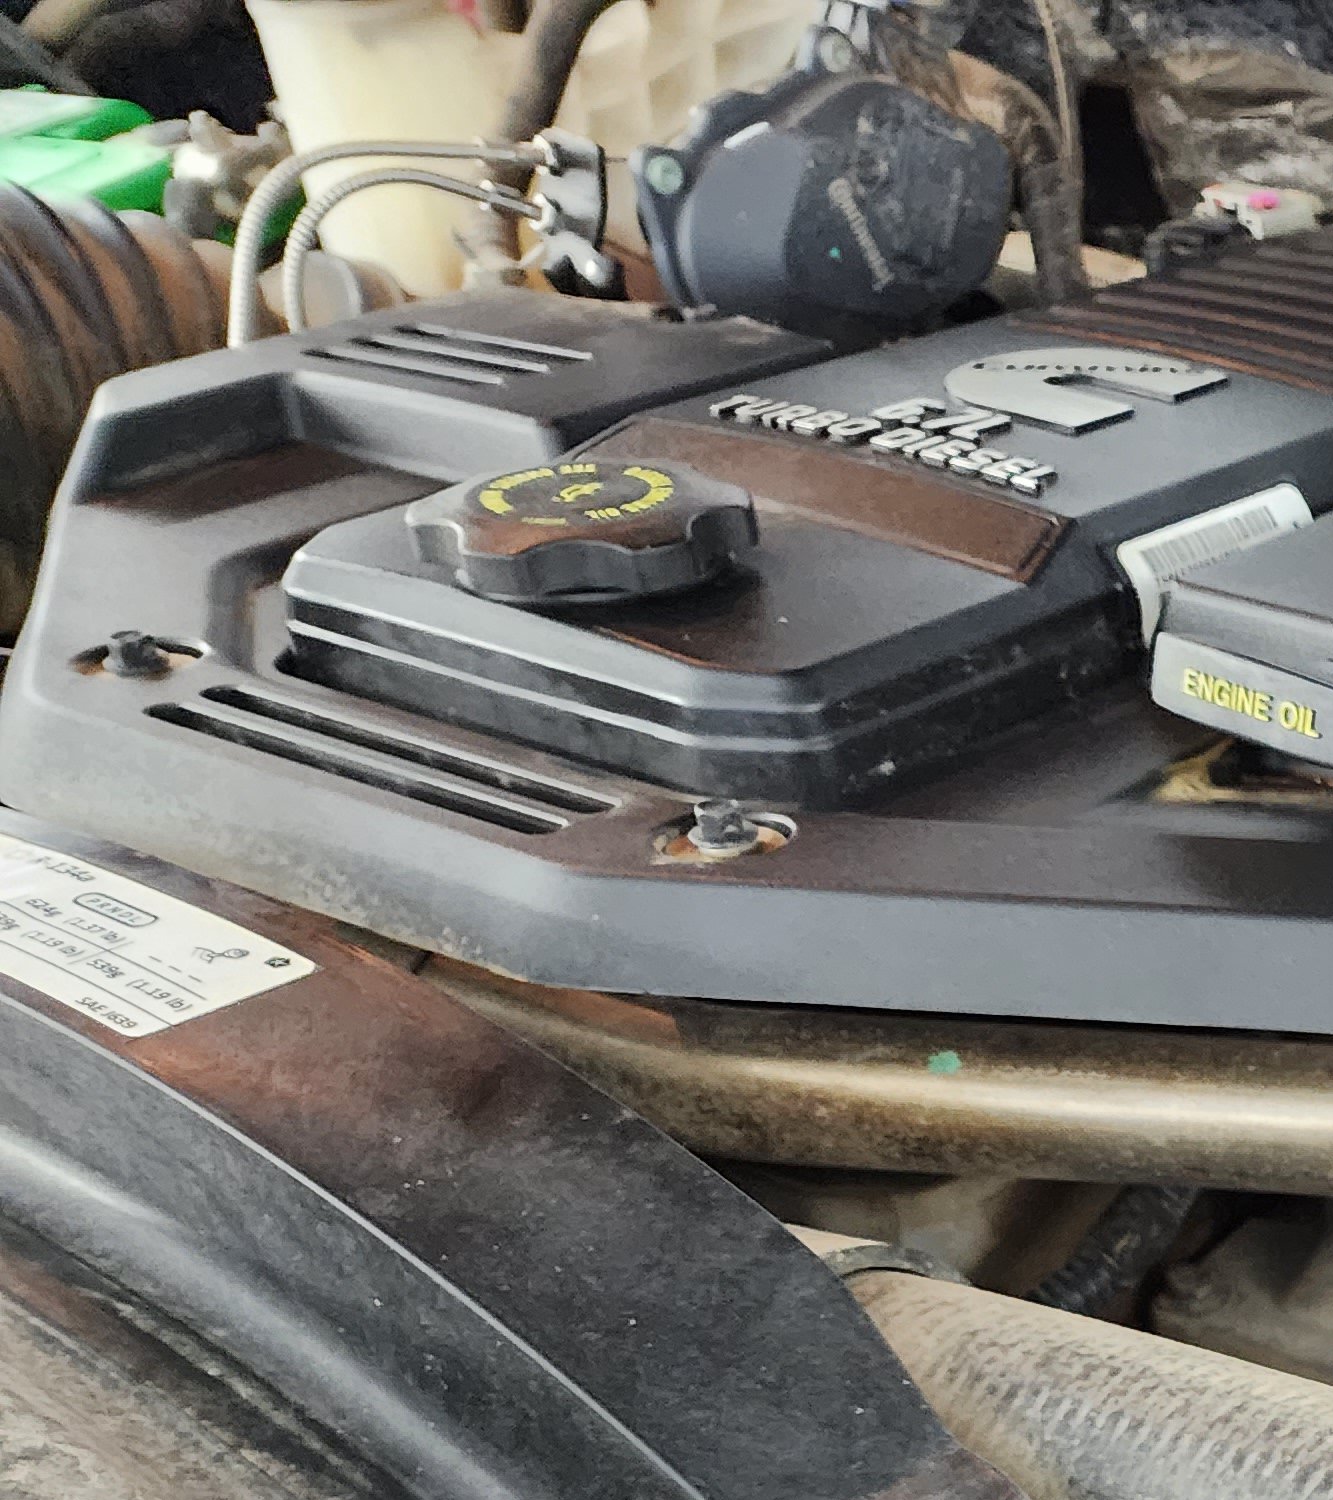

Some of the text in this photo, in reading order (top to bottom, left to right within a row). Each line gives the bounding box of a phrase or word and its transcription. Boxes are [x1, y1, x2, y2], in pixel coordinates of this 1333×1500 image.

[709, 393, 1058, 495] TURBO DIESEL
[1181, 667, 1322, 739] ENGINE OIL
